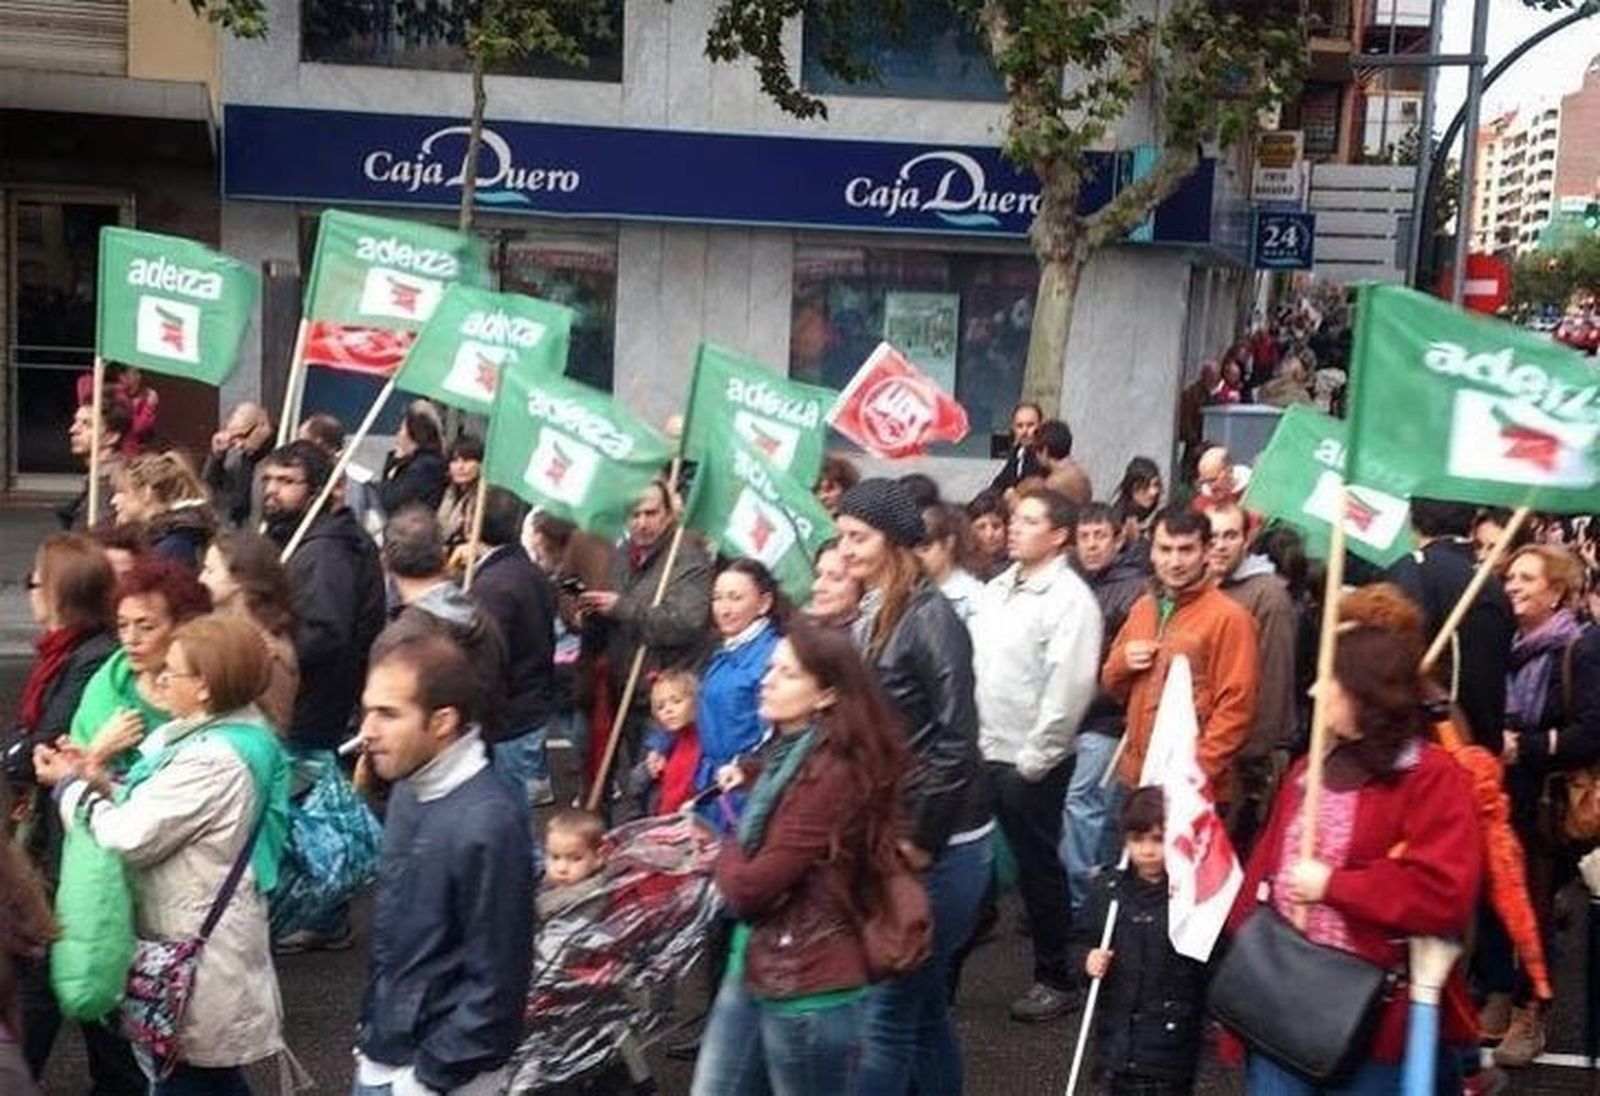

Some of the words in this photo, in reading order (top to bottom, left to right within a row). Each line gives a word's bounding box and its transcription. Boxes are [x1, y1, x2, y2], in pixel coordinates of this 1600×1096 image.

[364, 151, 444, 192] Caja
[425, 126, 580, 192] Duero
[844, 176, 920, 217] Caja
[1263, 225, 1299, 247] 24
